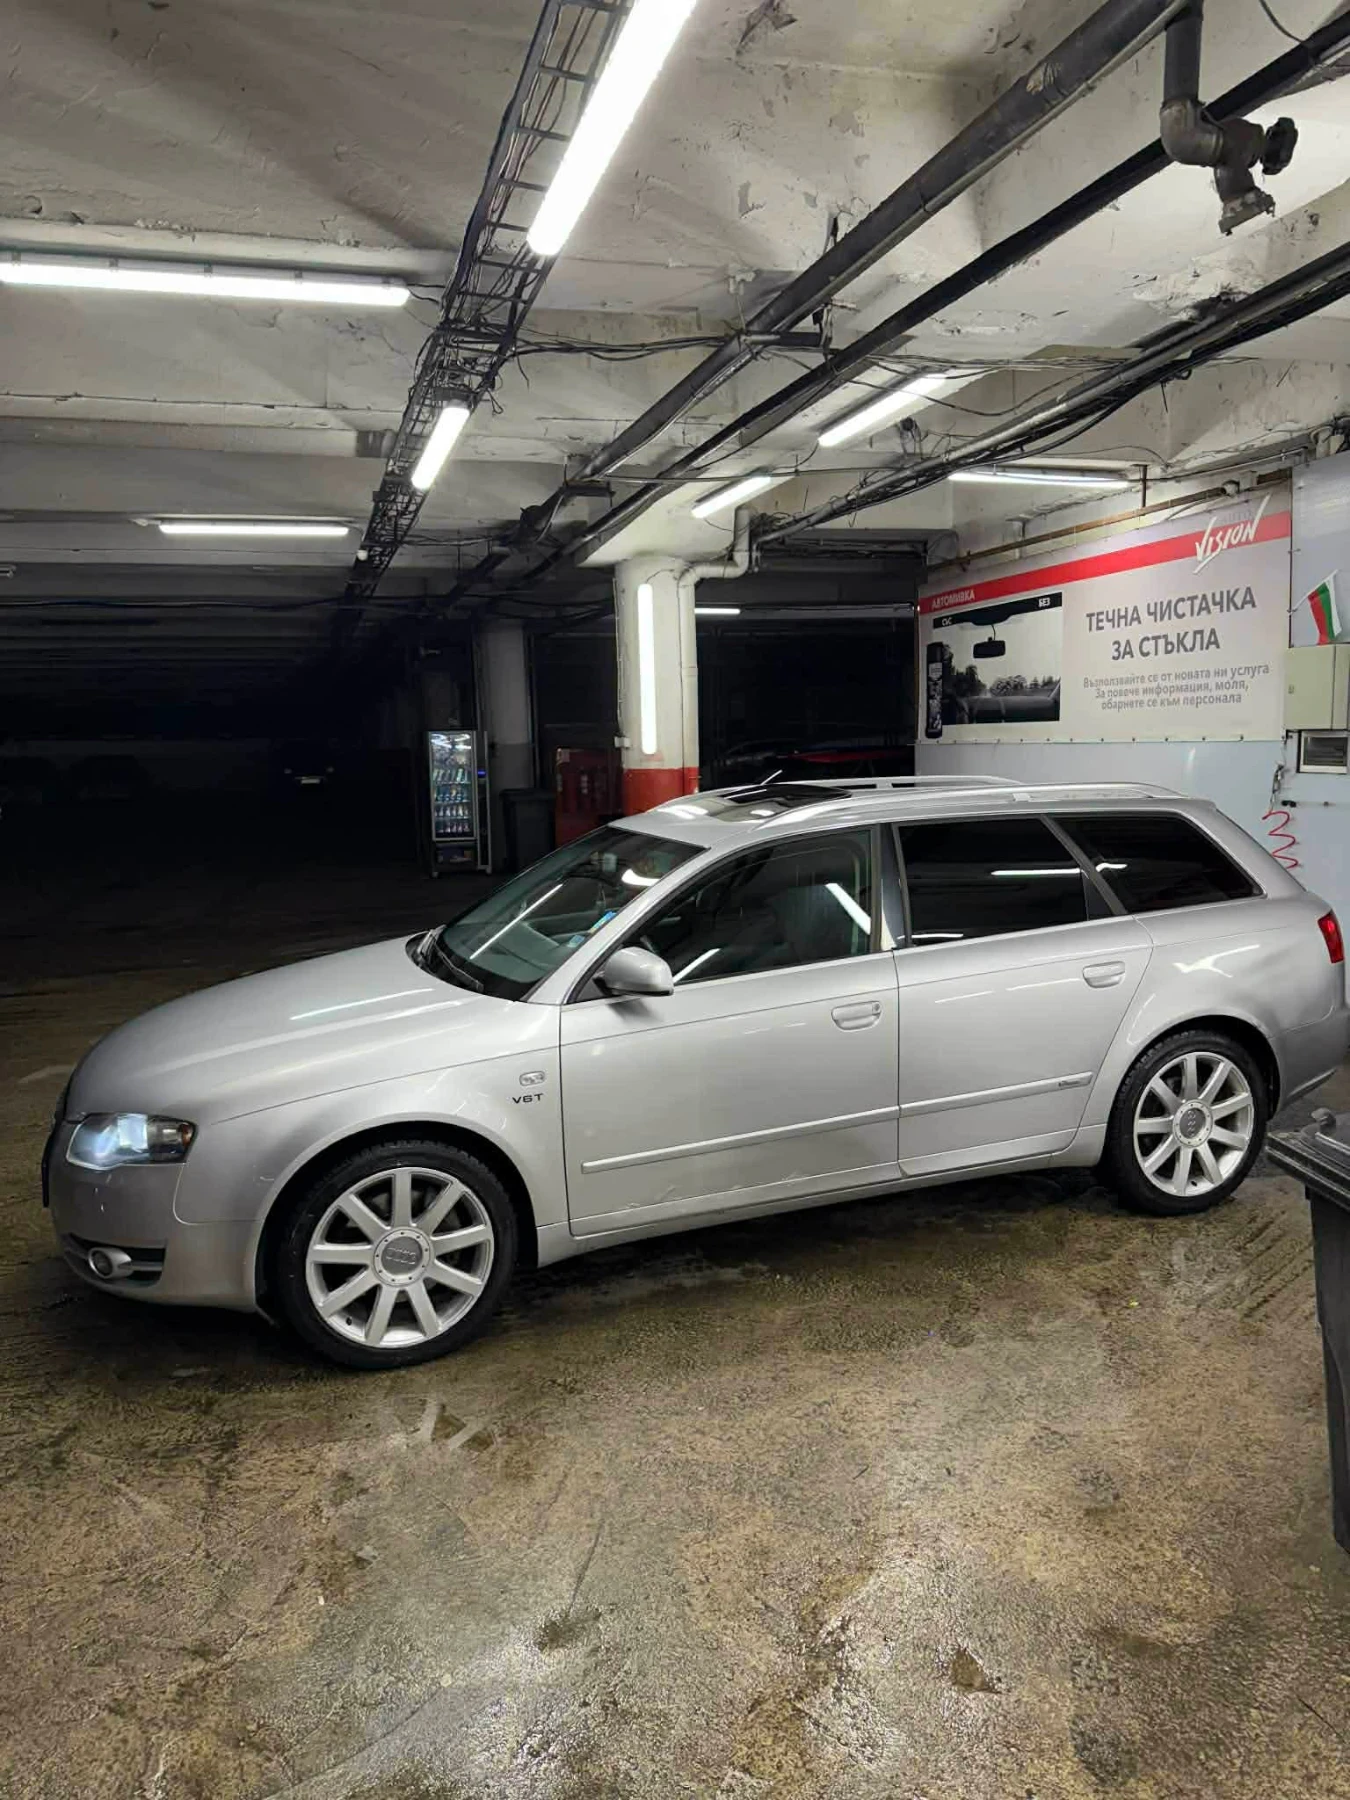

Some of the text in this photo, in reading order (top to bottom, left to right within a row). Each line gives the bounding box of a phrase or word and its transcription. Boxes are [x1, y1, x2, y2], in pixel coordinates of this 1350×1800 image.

[931, 589, 976, 611] АВТОМИВКА
[1038, 597, 1051, 608] БЕЗ
[1086, 586, 1257, 633] ТЕЧНА ЧИСТАЧКА
[1111, 627, 1221, 661] ЗА СТЪКЛА
[1147, 674, 1159, 683] се
[1160, 672, 1173, 682] от
[1174, 668, 1211, 681] новата
[1213, 667, 1228, 678] ни
[1230, 664, 1270, 680] услуга
[1095, 680, 1249, 699] За повече информация, моля,
[1146, 697, 1159, 708] се
[1160, 696, 1181, 707] към
[1182, 693, 1242, 708] персонала
[512, 1092, 544, 1104] V6T
